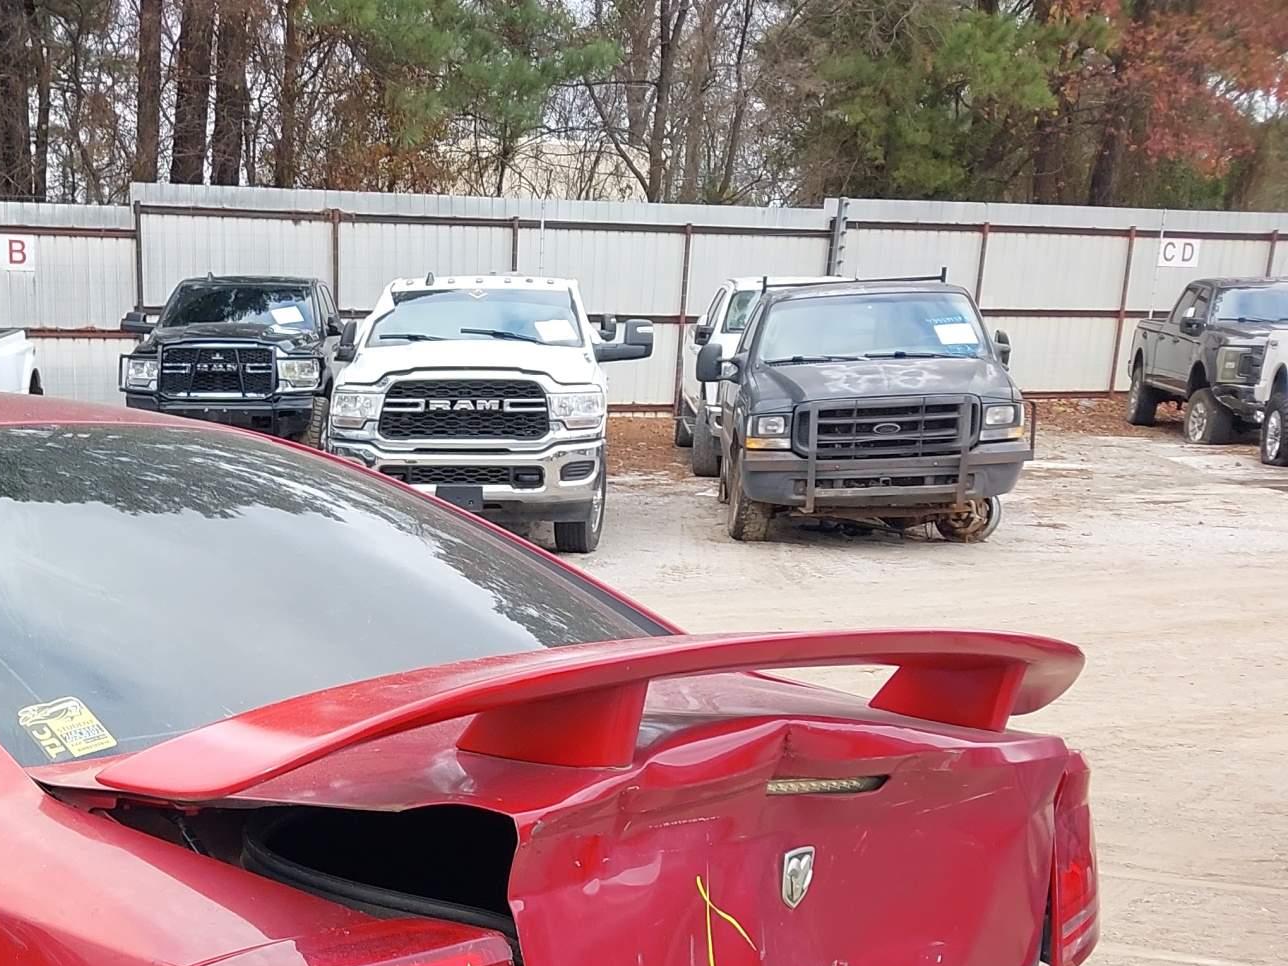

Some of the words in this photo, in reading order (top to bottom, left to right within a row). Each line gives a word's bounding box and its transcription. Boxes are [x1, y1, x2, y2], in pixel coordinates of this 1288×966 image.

[8, 239, 27, 264] B
[1163, 241, 1176, 262] C
[1181, 242, 1194, 262] D
[429, 399, 500, 411] RAM
